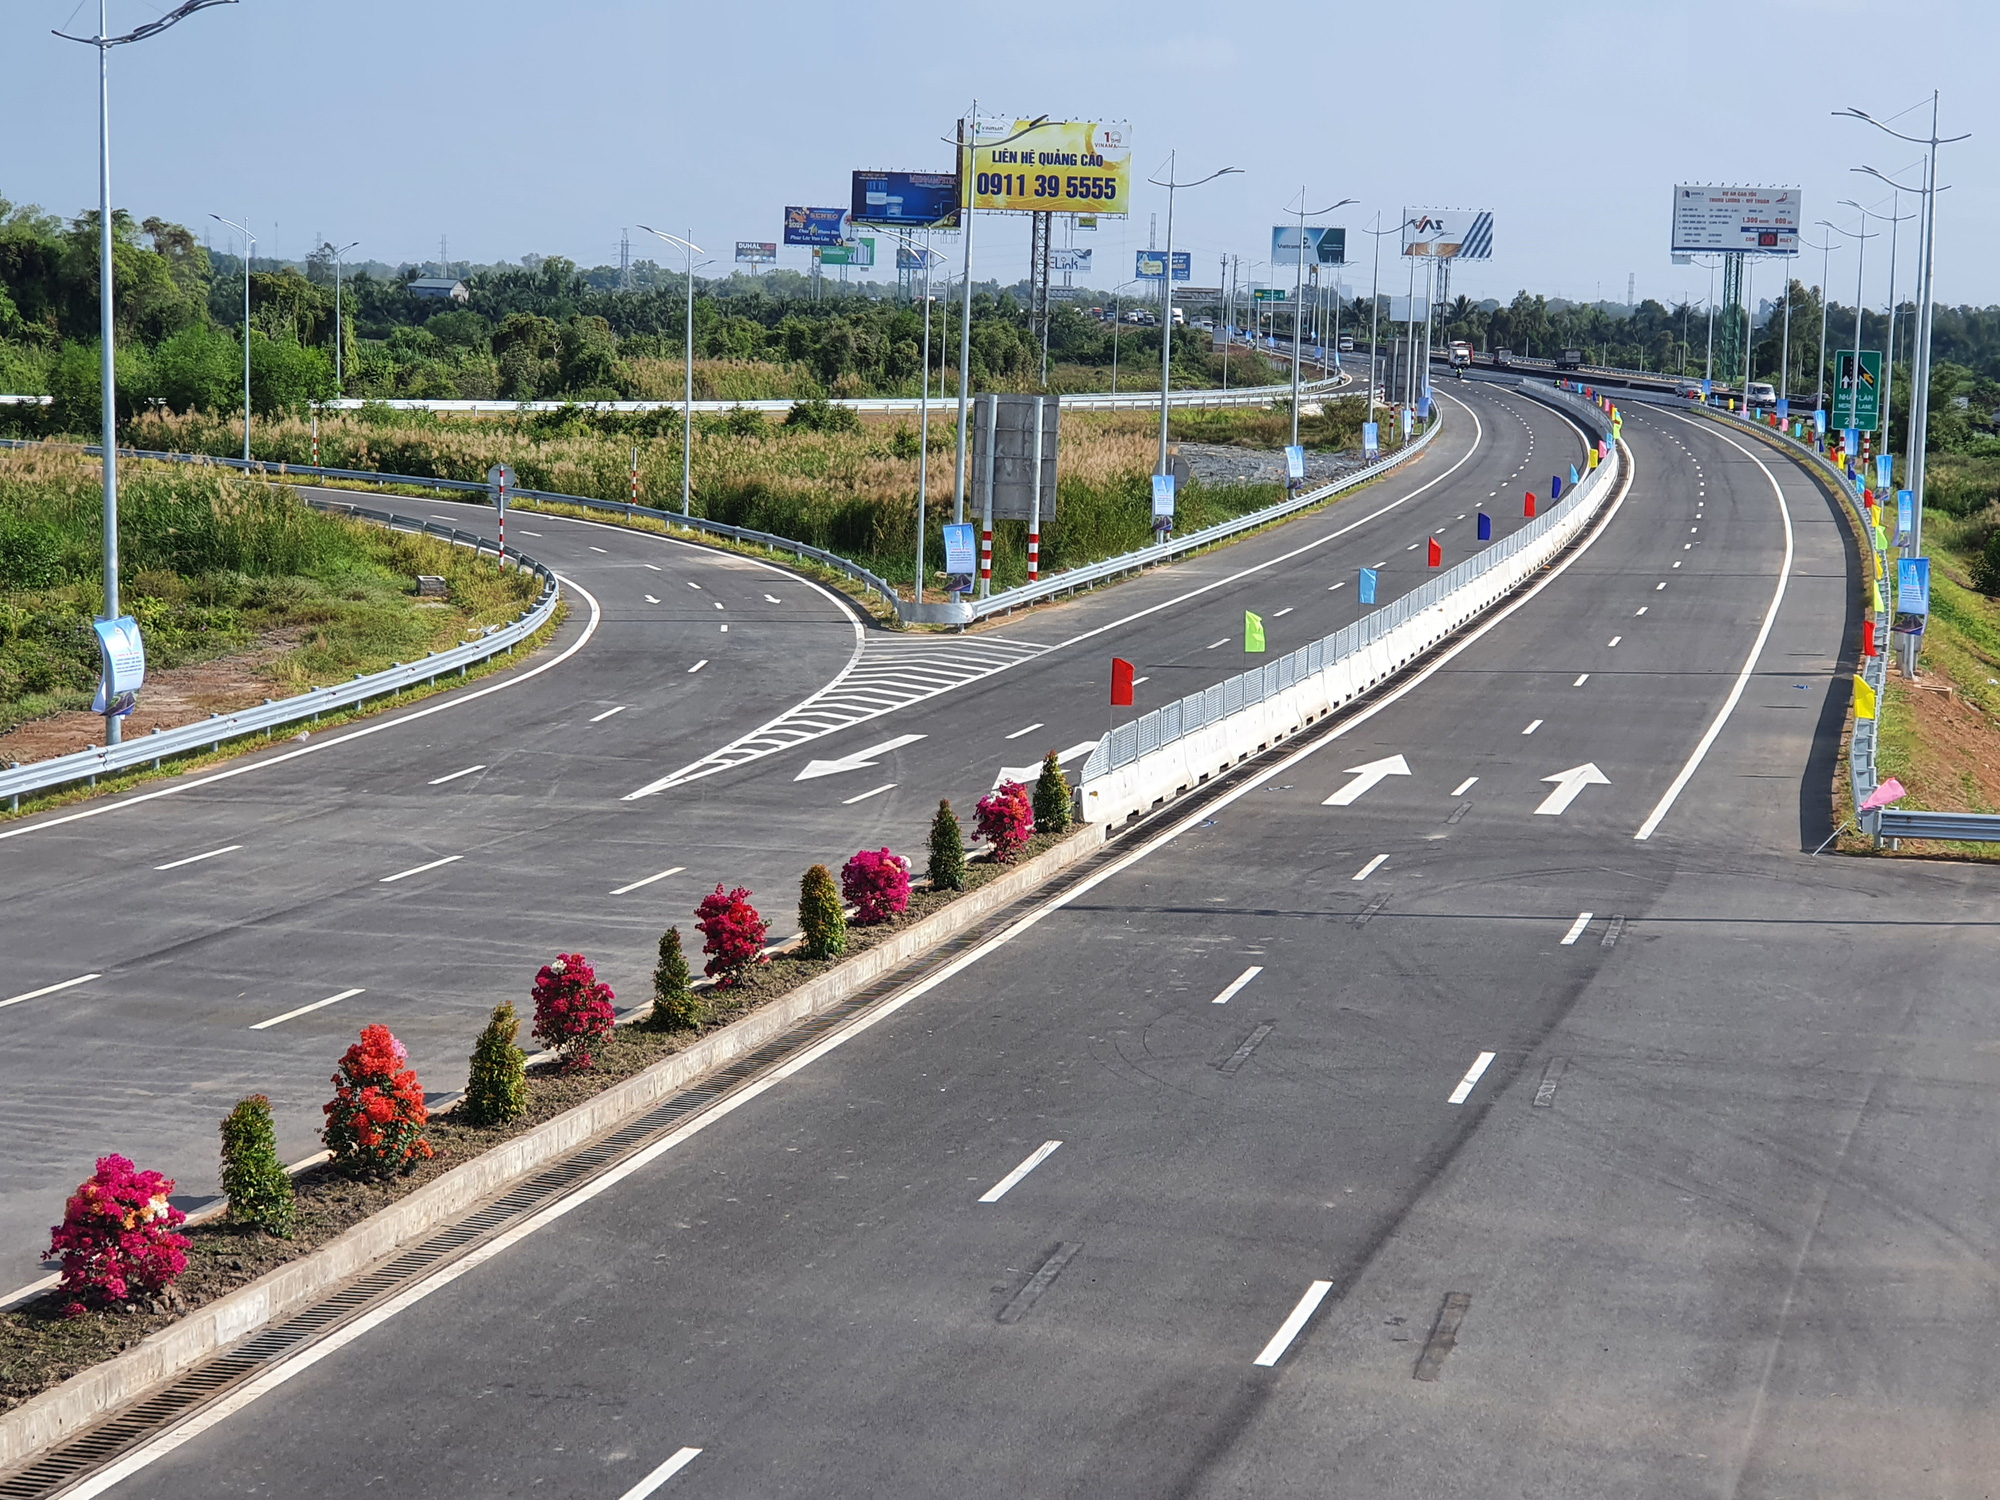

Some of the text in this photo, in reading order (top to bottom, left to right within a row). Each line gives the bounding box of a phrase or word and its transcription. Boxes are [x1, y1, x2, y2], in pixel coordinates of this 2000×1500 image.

[992, 148, 1104, 167] LIÊN HỆ QUẢNG CÁO
[976, 172, 1117, 200] 0911 39 5555
